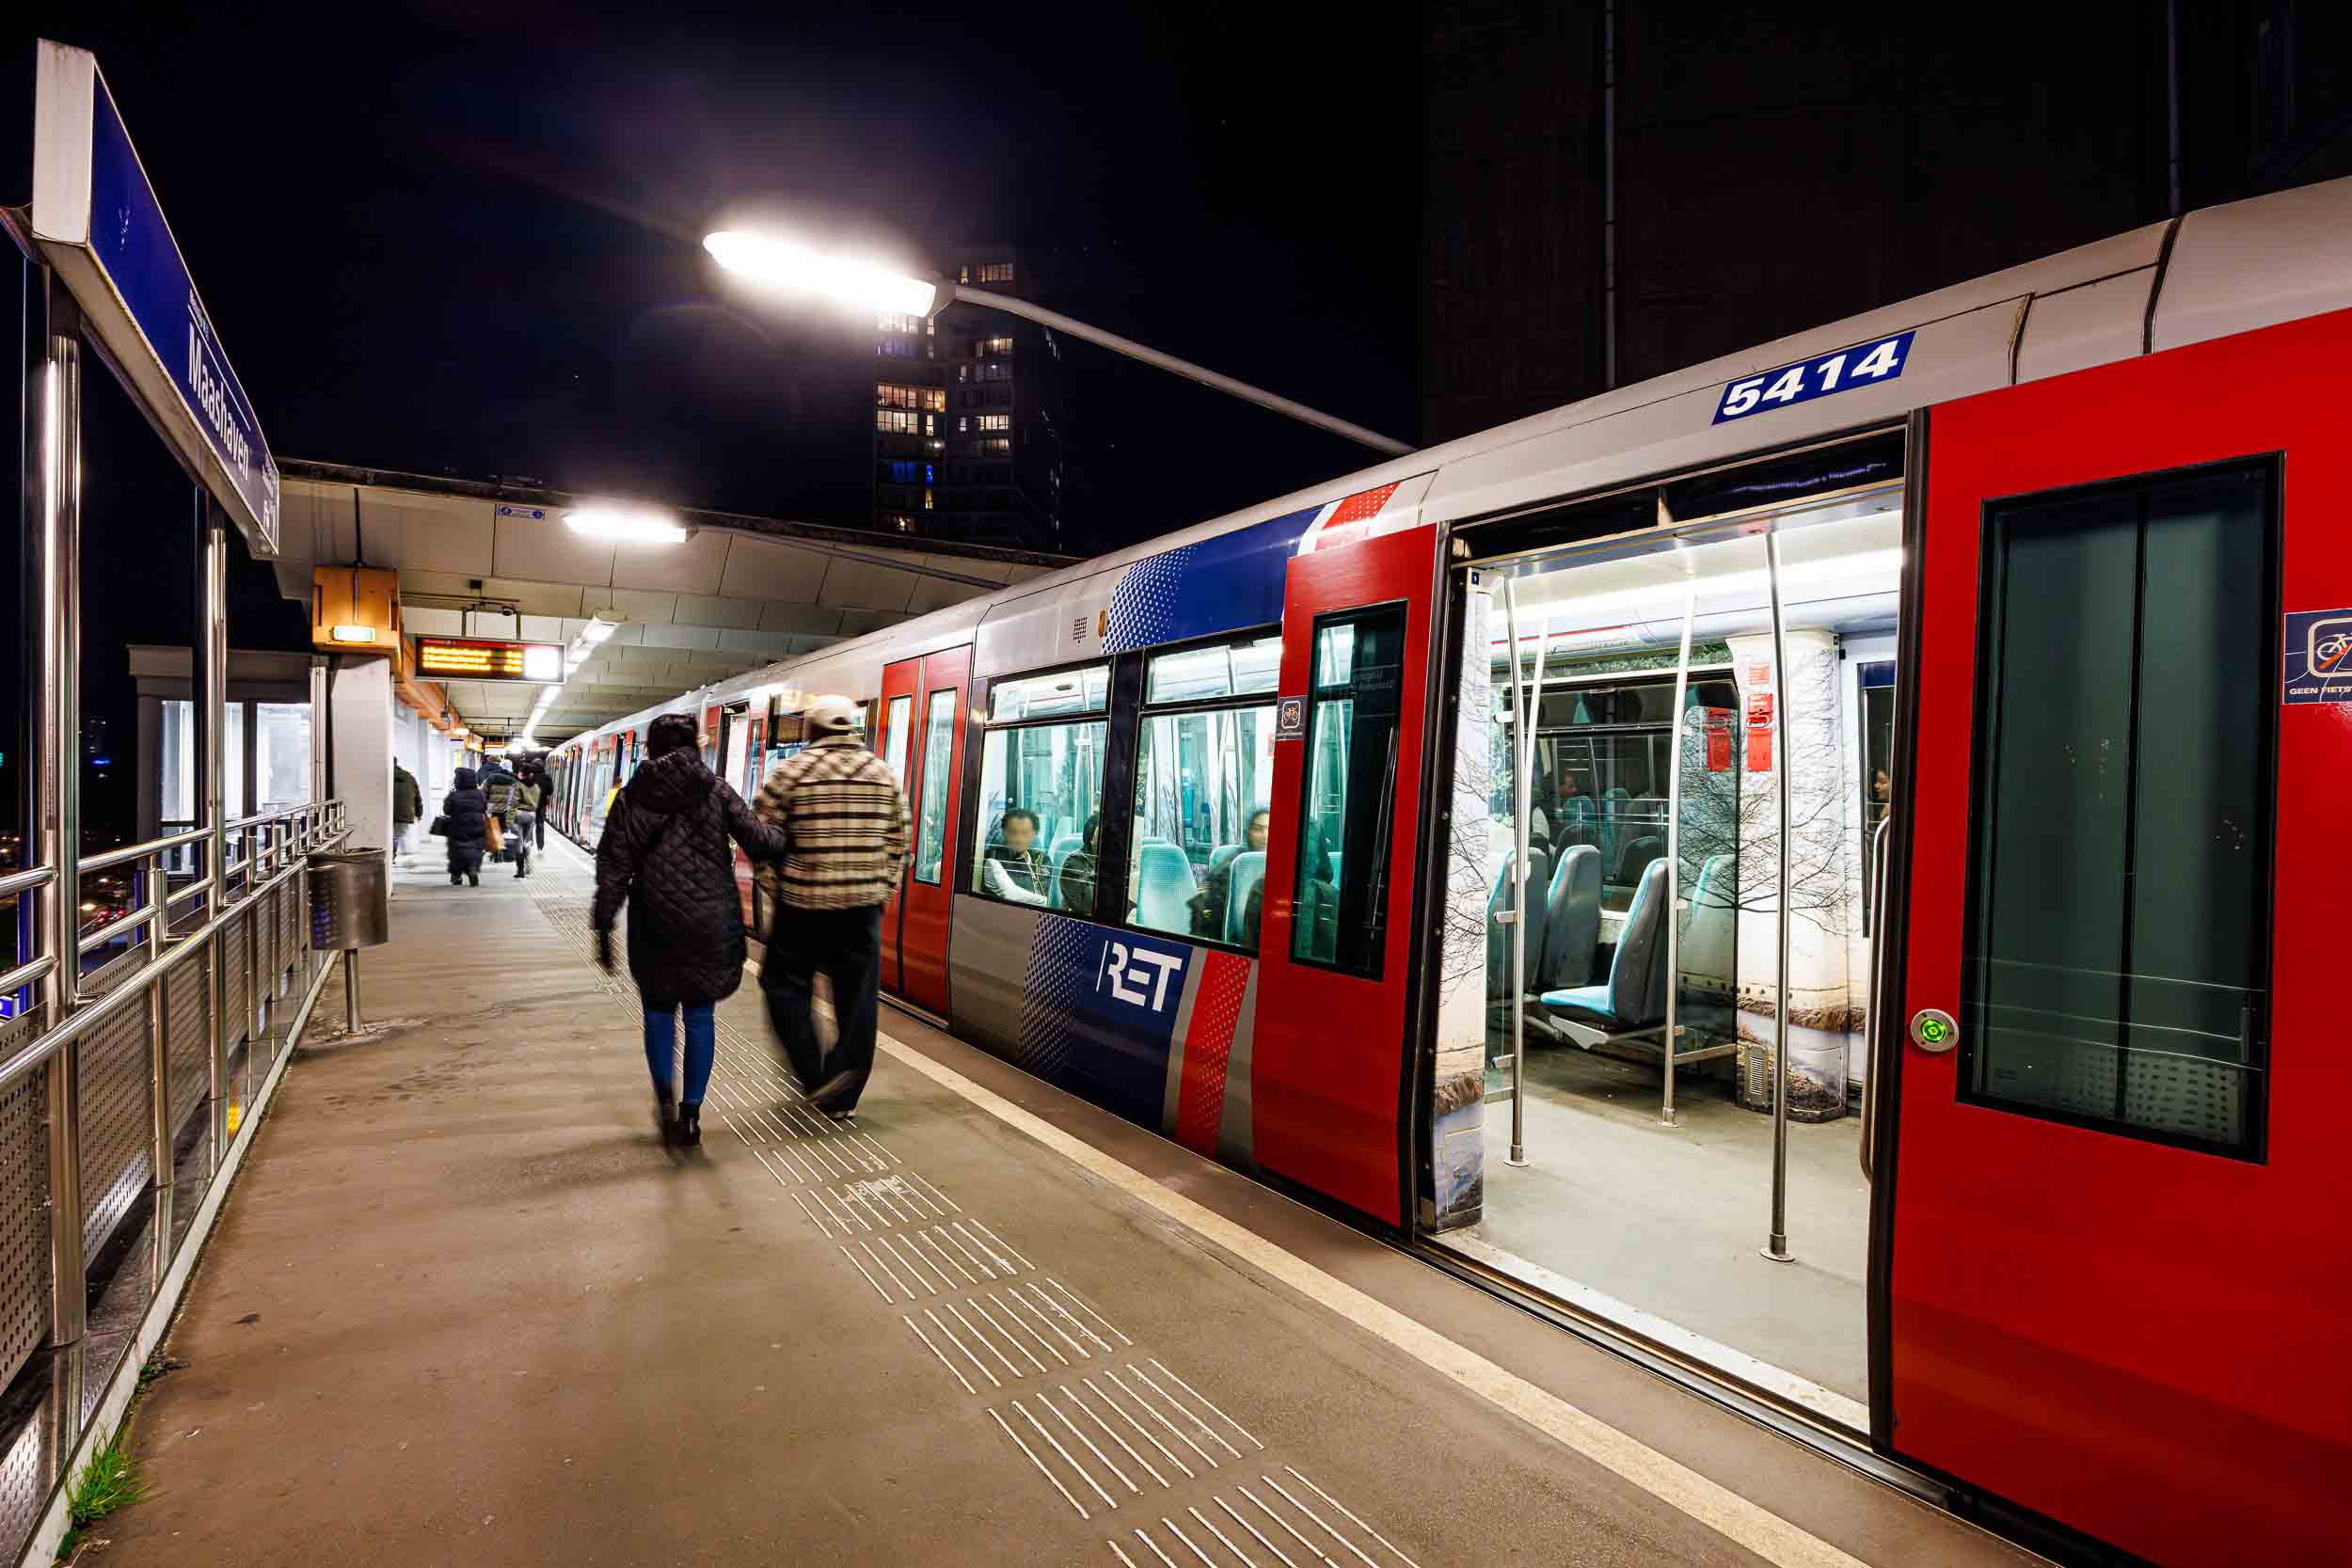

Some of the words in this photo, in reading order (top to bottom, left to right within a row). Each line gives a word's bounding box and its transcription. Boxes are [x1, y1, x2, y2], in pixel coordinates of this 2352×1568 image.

[188, 322, 249, 482] Maashaven
[1723, 340, 1899, 416] 5414
[1096, 941, 1183, 1012] RET
